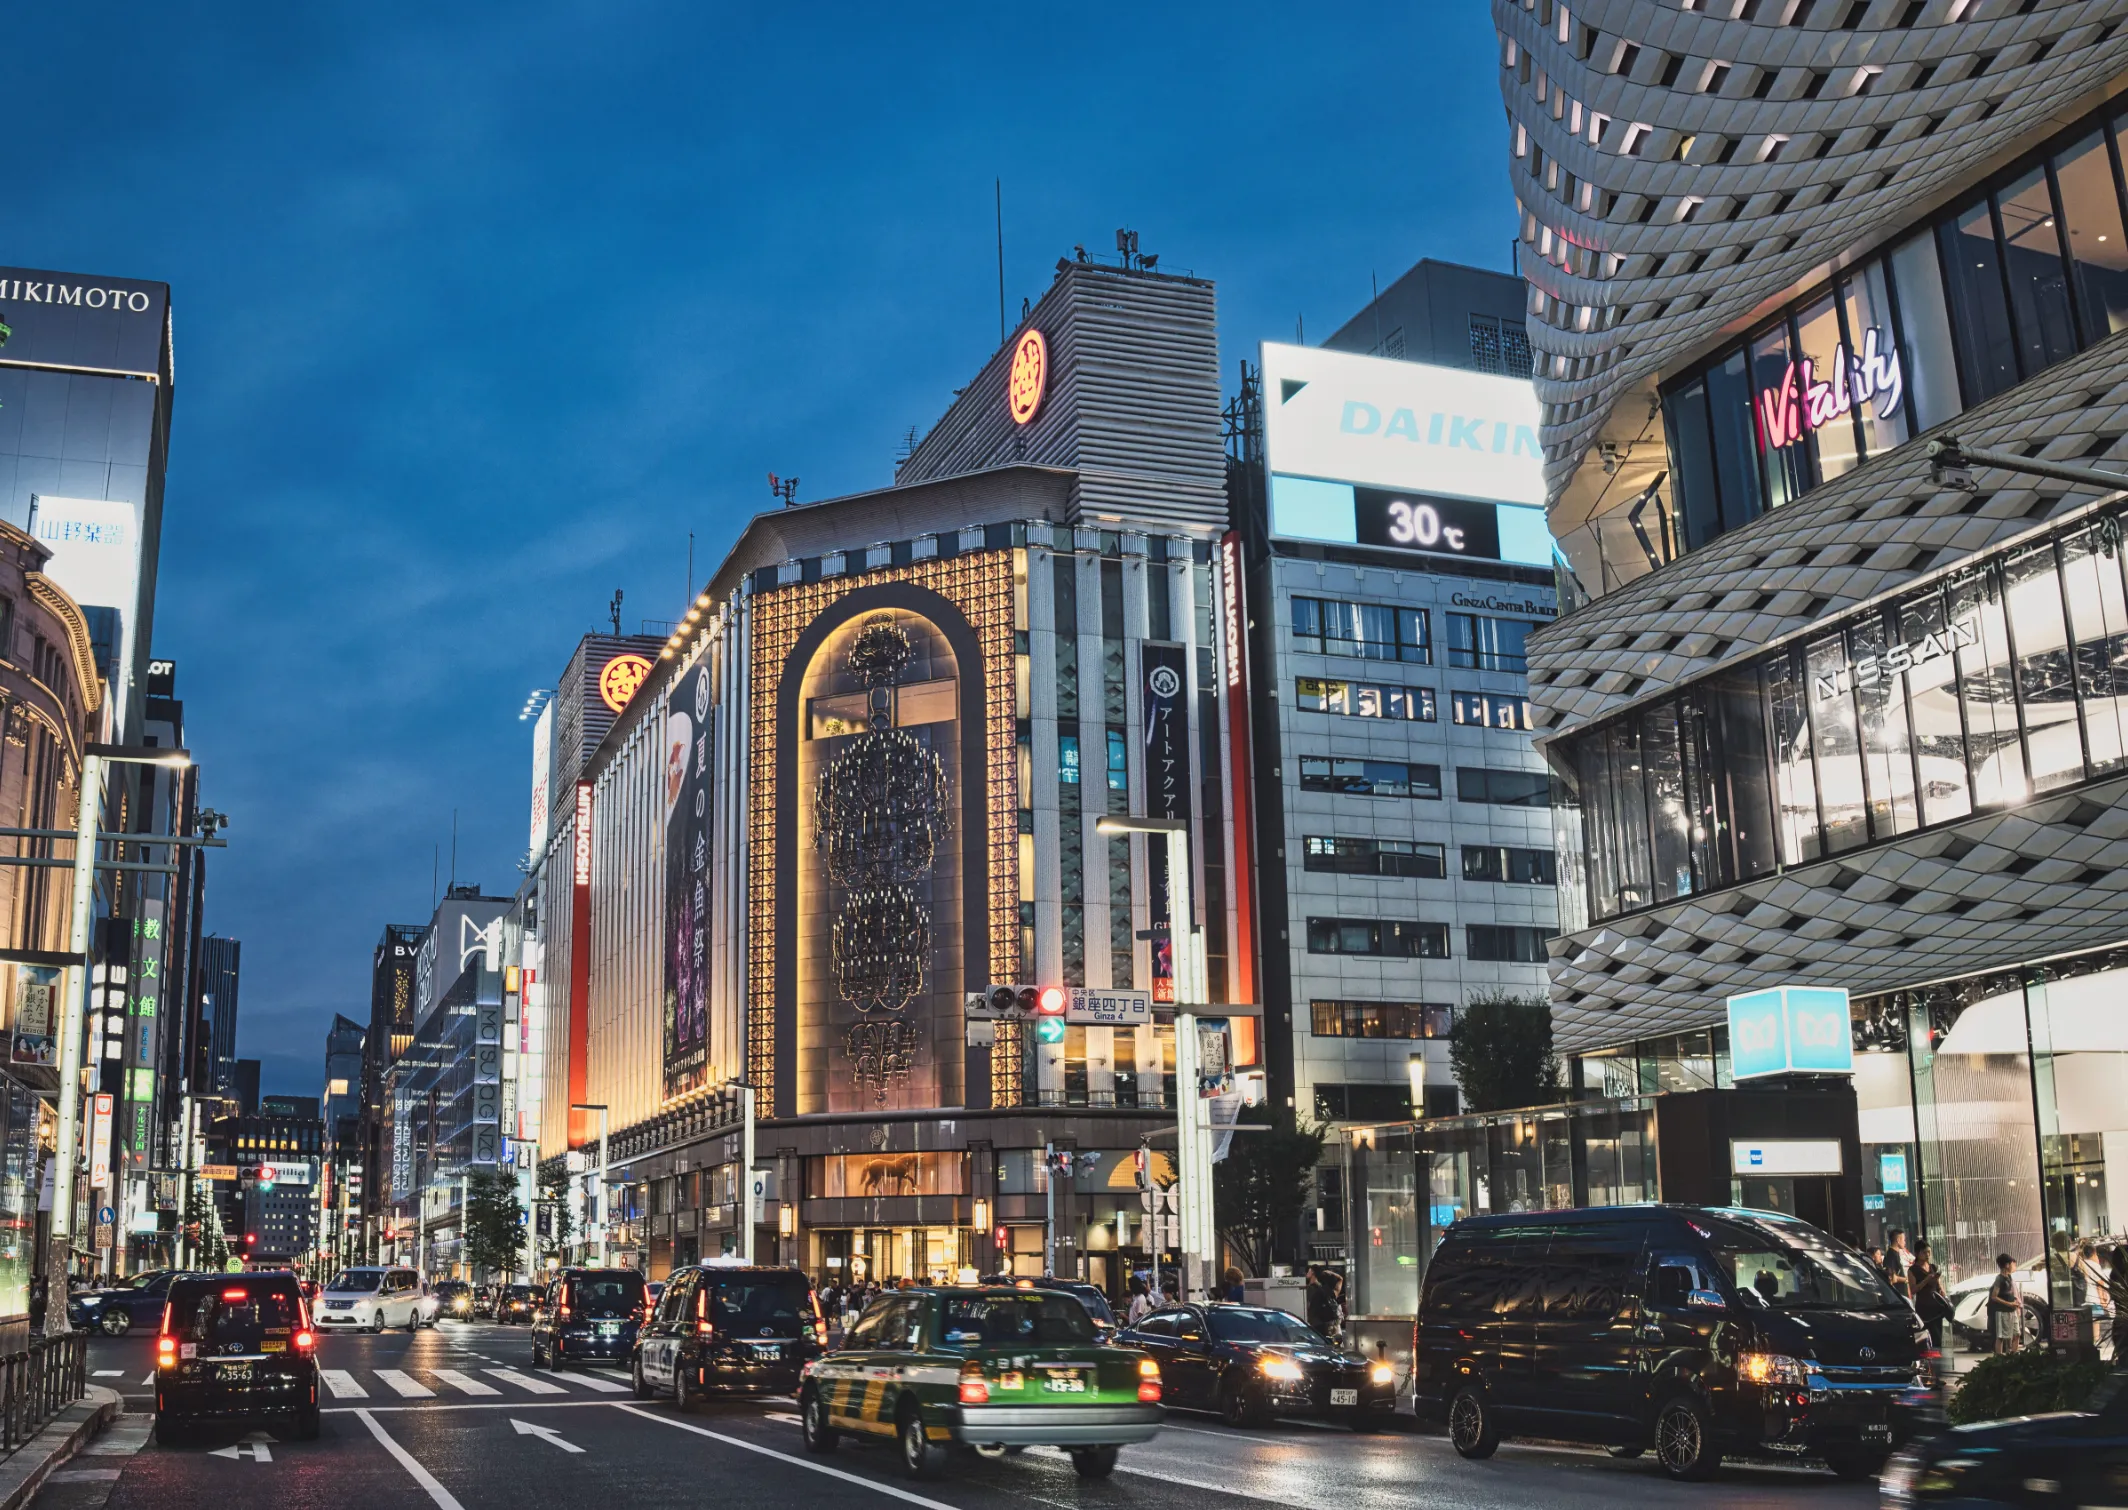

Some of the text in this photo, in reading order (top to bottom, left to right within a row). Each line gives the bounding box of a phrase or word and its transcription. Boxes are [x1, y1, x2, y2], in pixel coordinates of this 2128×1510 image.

[1764, 327, 1902, 449] Vitality
[1813, 615, 1977, 702] NISSAN
[576, 785, 591, 885] MITSUKOSHI
[139, 917, 160, 1018] 教文館
[1072, 988, 1096, 997] 中央区
[1072, 996, 1145, 1013] 銀座四丁目
[1094, 1012, 1124, 1021] Ginza 4
